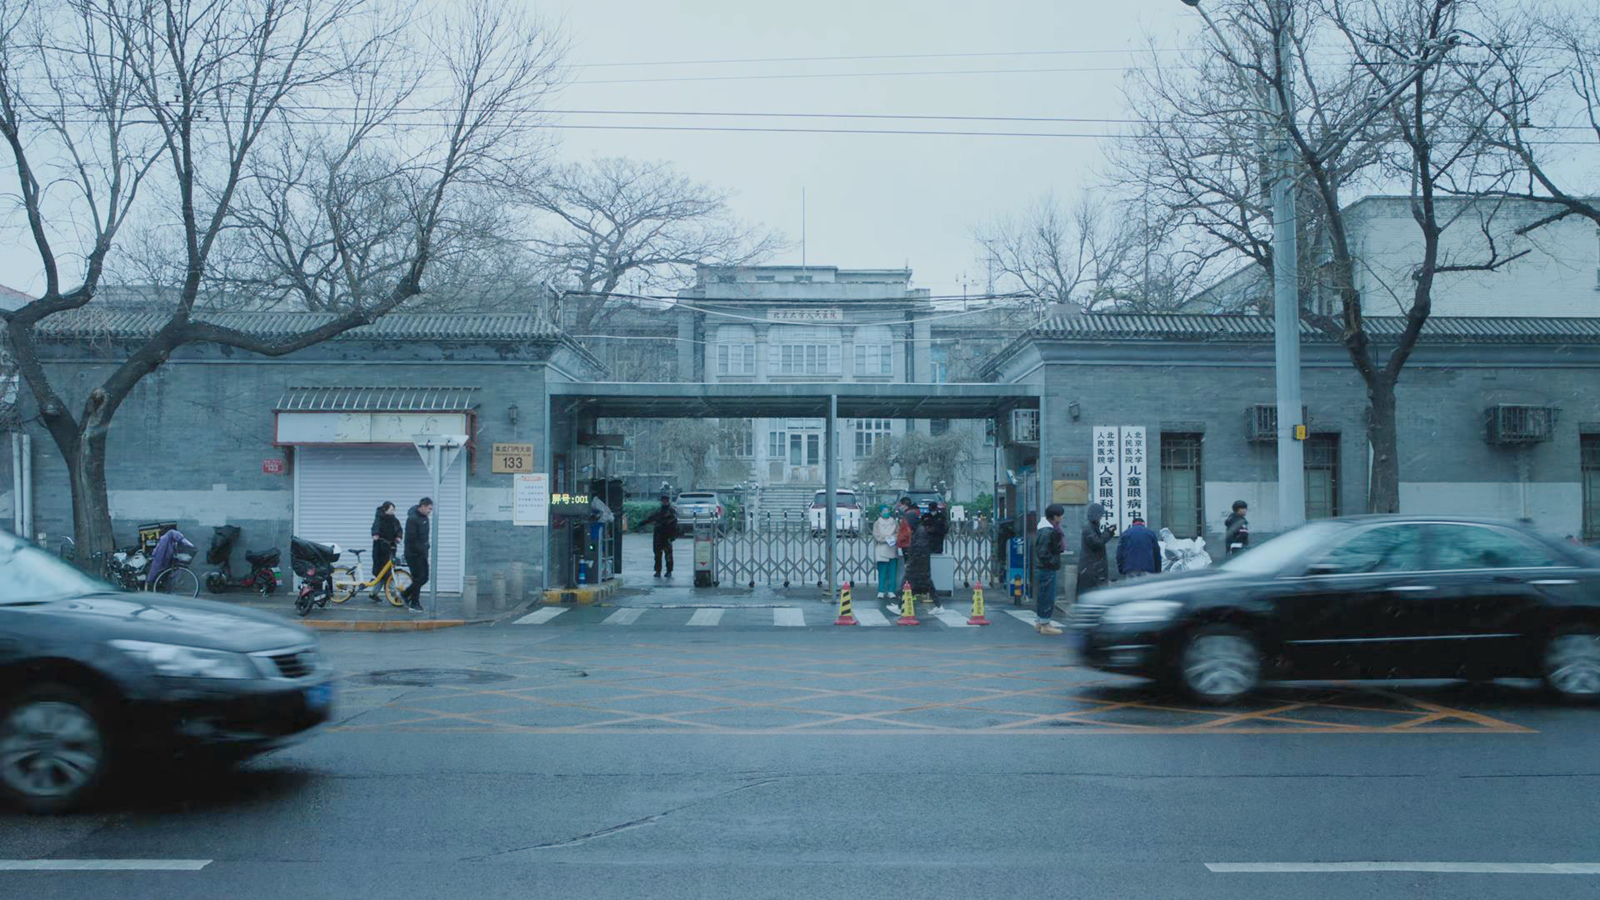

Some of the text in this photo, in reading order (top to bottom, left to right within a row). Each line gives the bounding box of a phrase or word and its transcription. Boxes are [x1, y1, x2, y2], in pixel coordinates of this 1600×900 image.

[503, 457, 523, 468] 133
[1097, 431, 1105, 463] 人民医院
[1107, 431, 1115, 463] 北京大学
[1125, 431, 1133, 463] 人民医院
[1134, 431, 1143, 463] 北京大学
[552, 493, 588, 504] 屏号:001
[1127, 465, 1142, 529] 儿童眼病中
